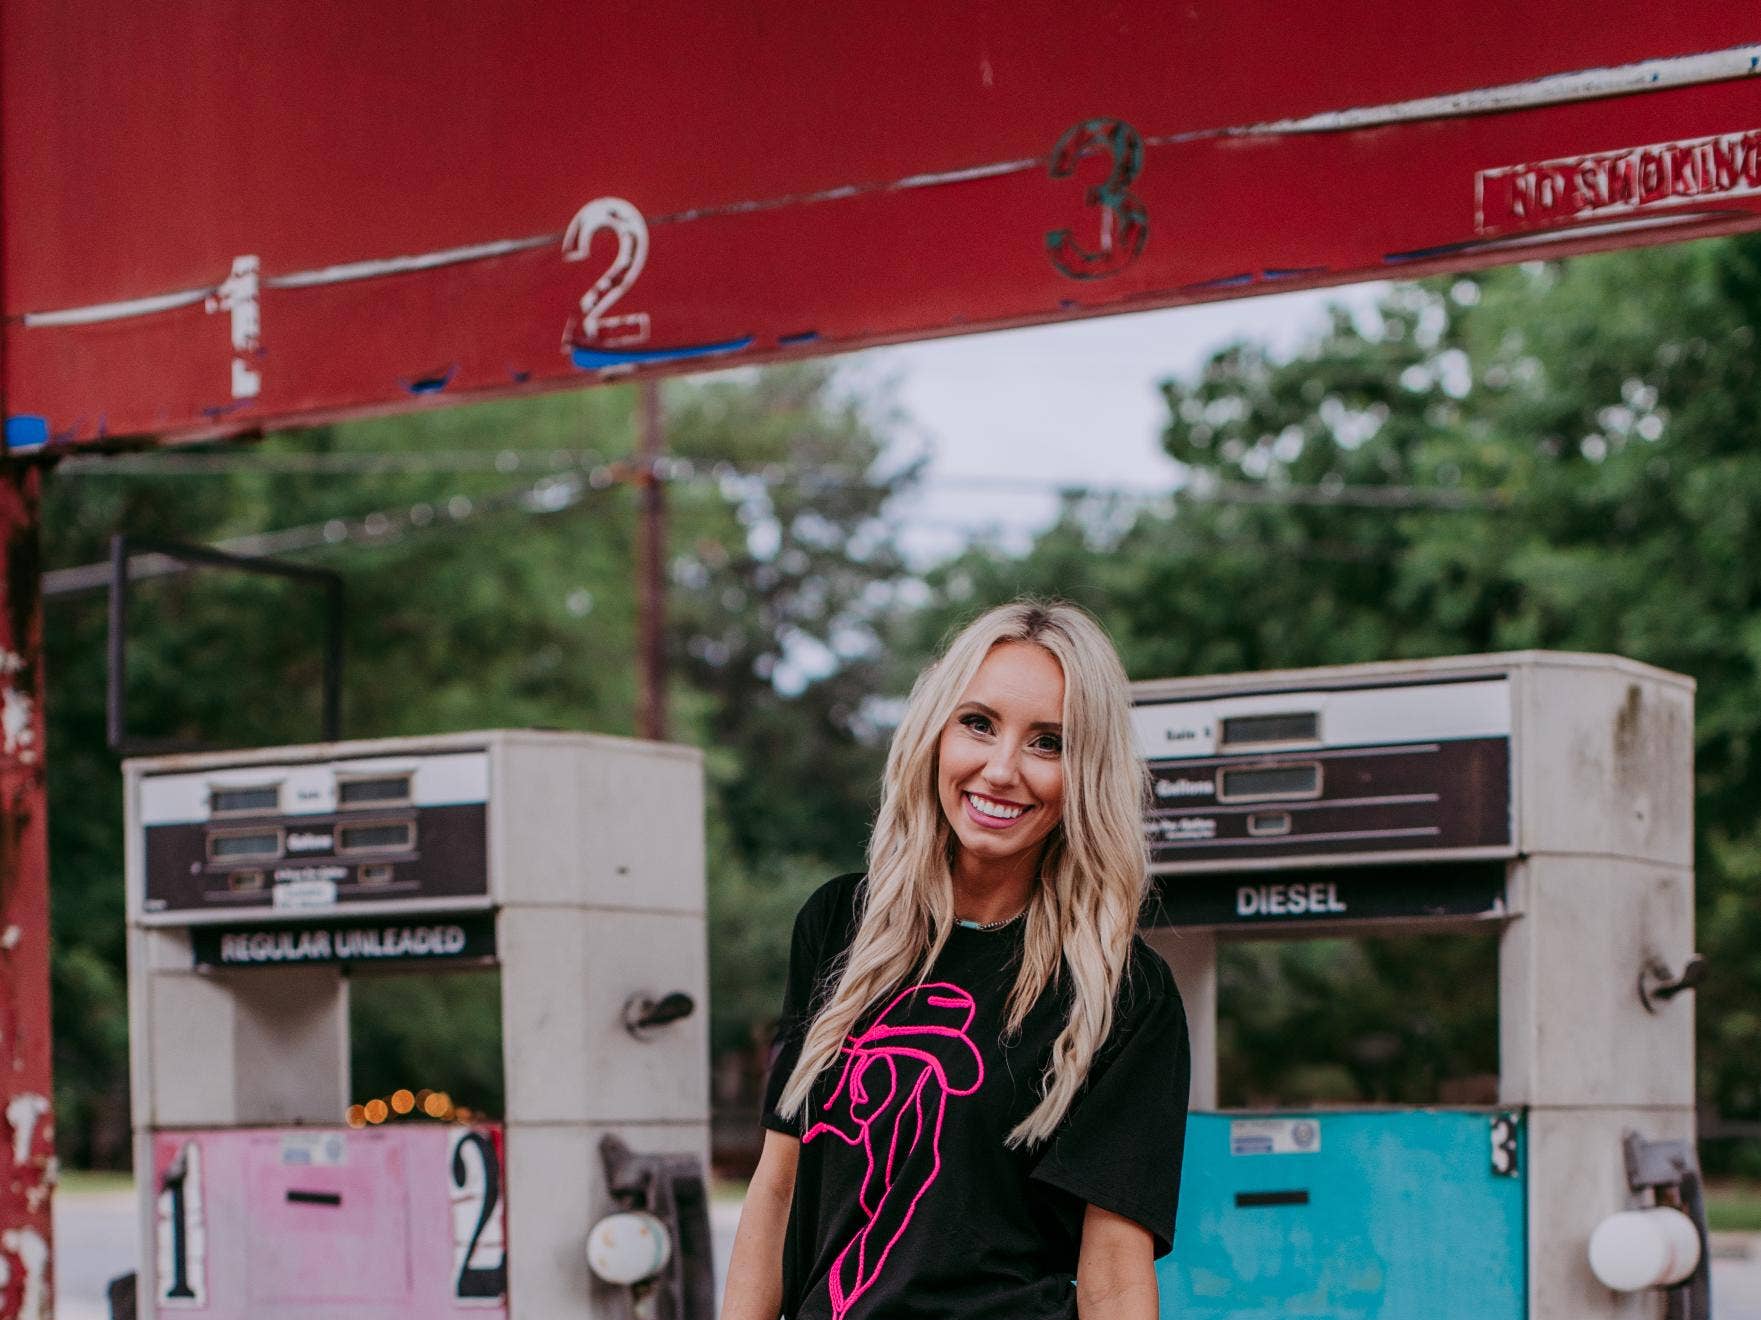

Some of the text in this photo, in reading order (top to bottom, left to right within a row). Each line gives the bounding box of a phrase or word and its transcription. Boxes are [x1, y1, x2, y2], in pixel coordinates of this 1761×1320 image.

[1045, 116, 1149, 282] 3
[1510, 168, 1563, 217] NO
[204, 253, 261, 398] 1
[562, 196, 651, 354] 2
[220, 926, 466, 962] REGULAR UNLEADED
[1236, 882, 1347, 916] DIESEL
[162, 1150, 197, 1298] 1
[452, 1131, 506, 1297] 2
